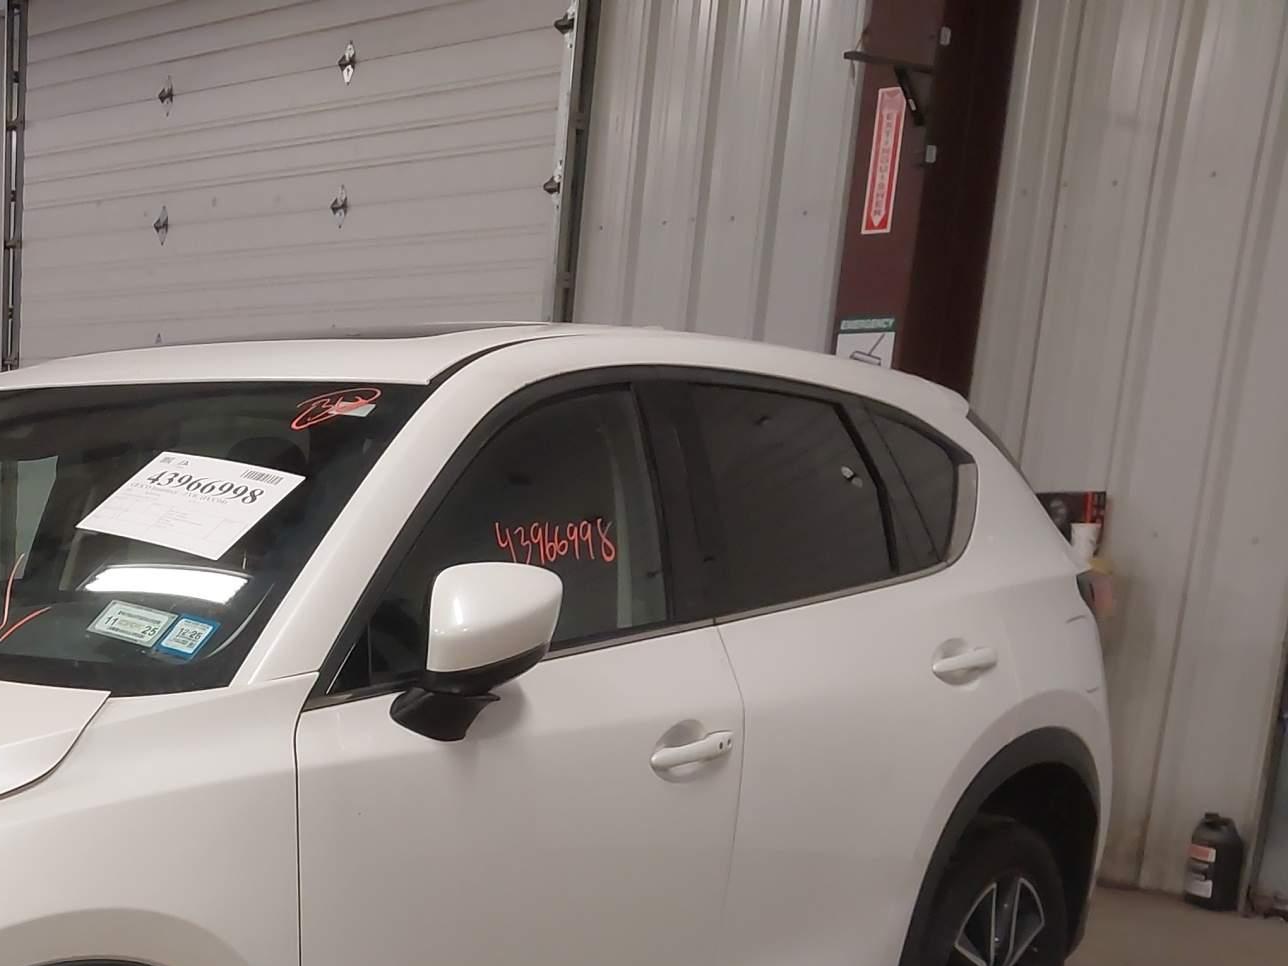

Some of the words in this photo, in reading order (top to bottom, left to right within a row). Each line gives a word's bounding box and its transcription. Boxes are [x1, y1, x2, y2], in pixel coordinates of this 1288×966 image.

[146, 469, 265, 505] 43966998
[495, 518, 616, 565] 43966998
[104, 615, 119, 626] 11
[140, 625, 159, 637] 25
